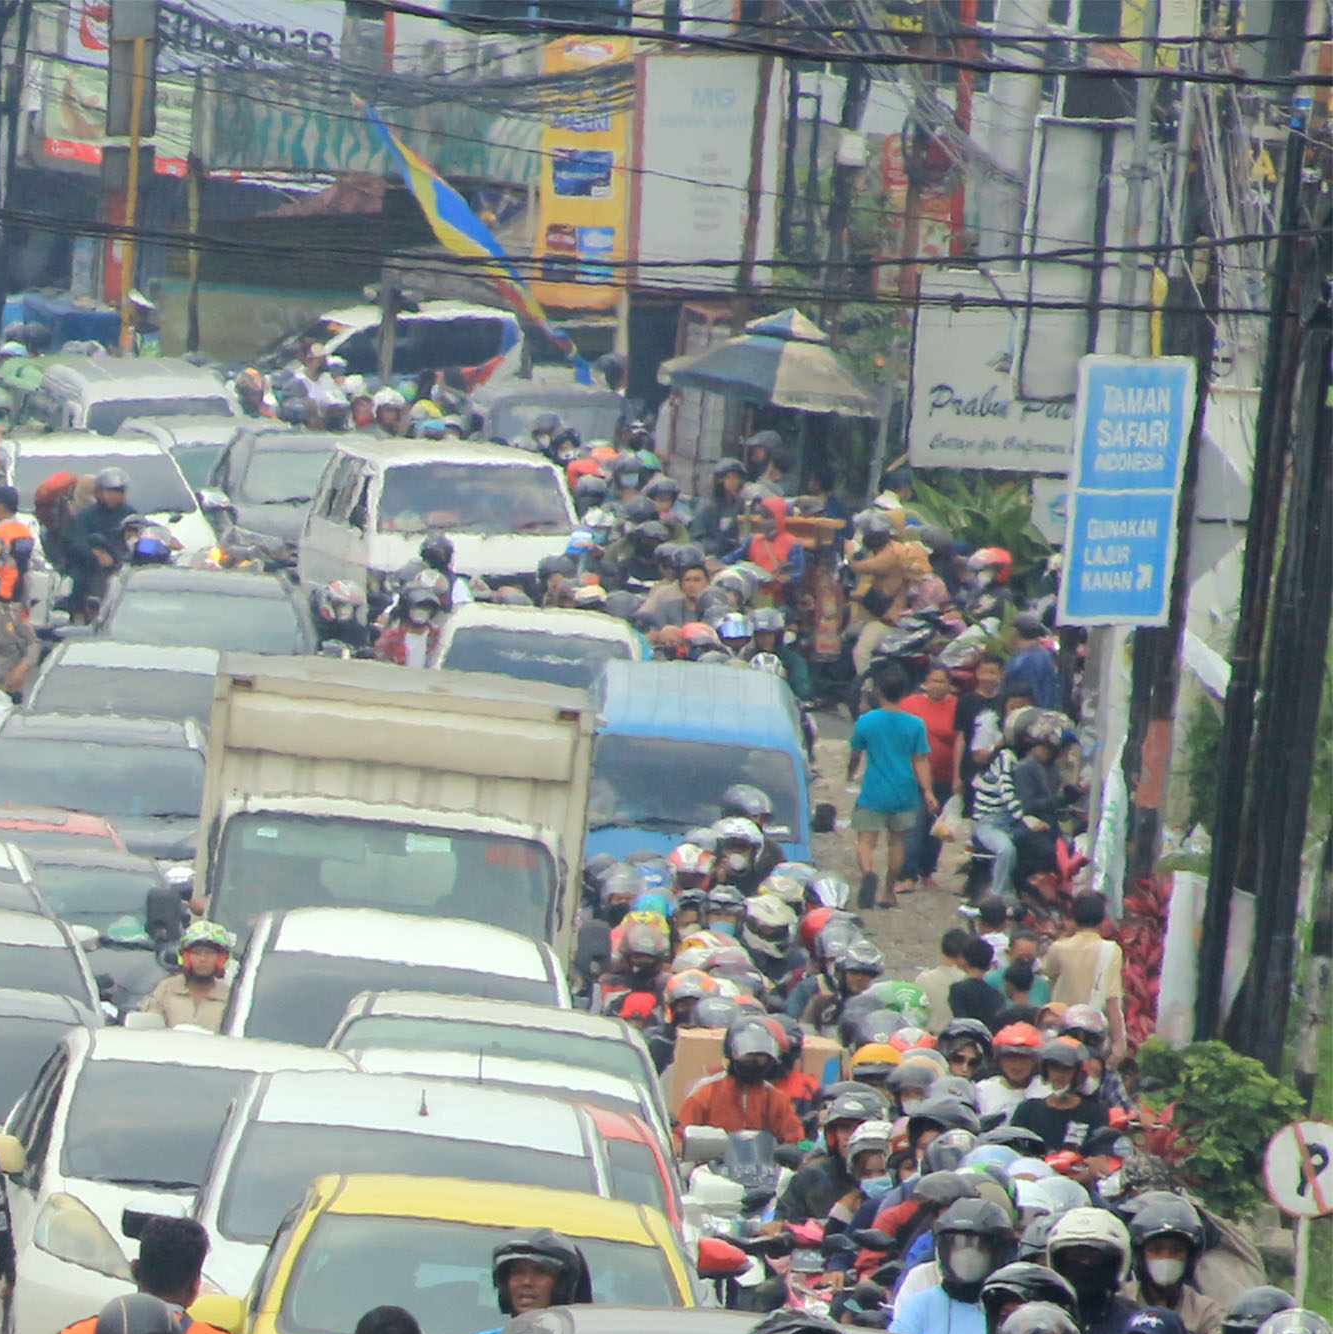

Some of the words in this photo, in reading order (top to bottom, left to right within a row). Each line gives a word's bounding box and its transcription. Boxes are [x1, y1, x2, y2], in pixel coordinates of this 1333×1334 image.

[1102, 386, 1171, 415] TAMAN
[1096, 420, 1170, 449] SAFARI
[1094, 453, 1165, 472] INDONESIA
[1086, 518, 1158, 540] GUNAKAN
[1084, 546, 1131, 566] LAJUR
[1081, 570, 1134, 592] KANAN
